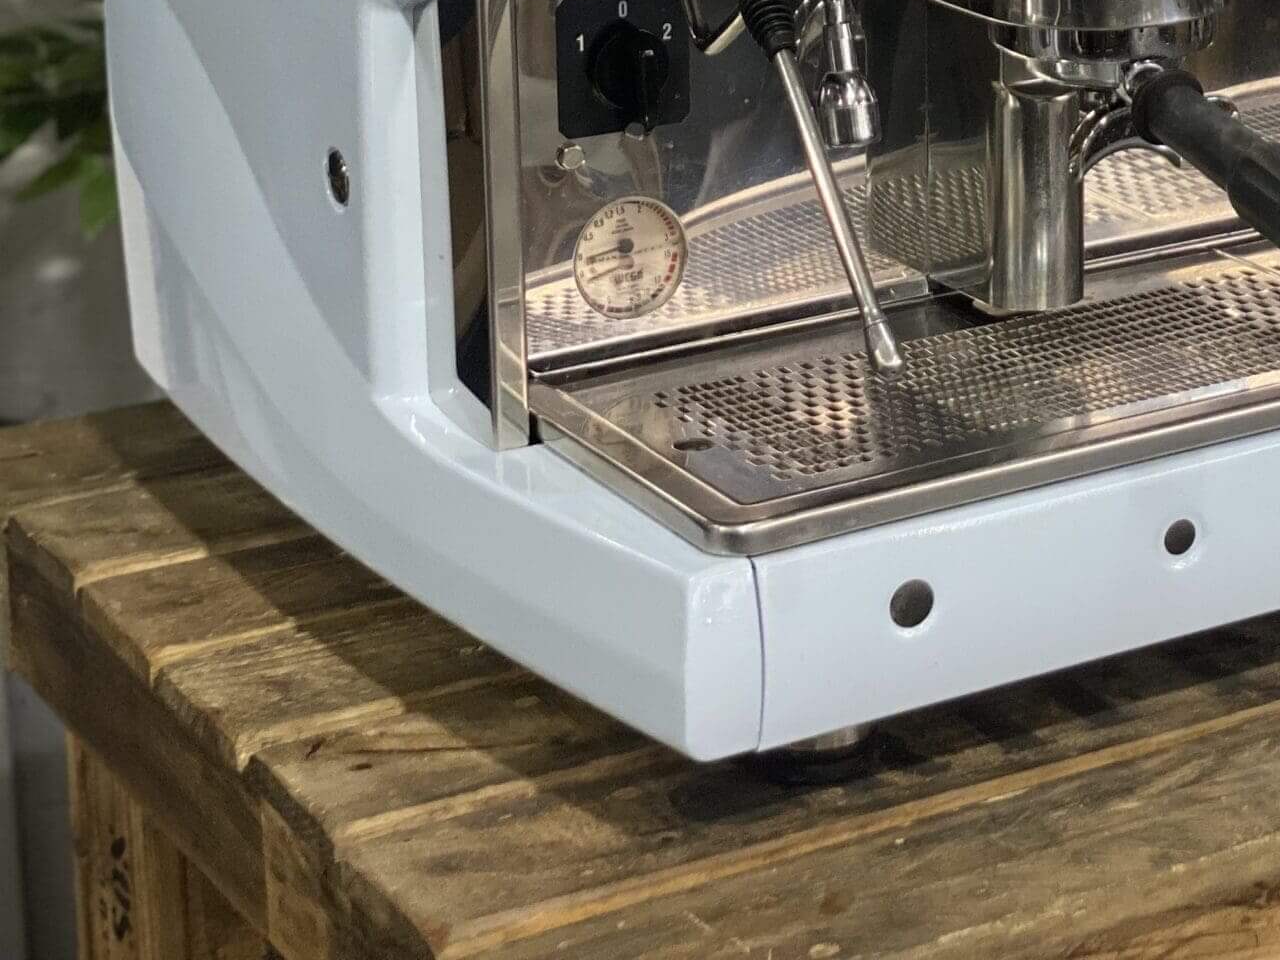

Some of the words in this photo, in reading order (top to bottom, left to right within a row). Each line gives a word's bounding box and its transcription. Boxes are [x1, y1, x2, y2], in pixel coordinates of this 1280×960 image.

[618, 0, 628, 18] 0
[662, 22, 672, 40] 2
[575, 33, 584, 52] 1
